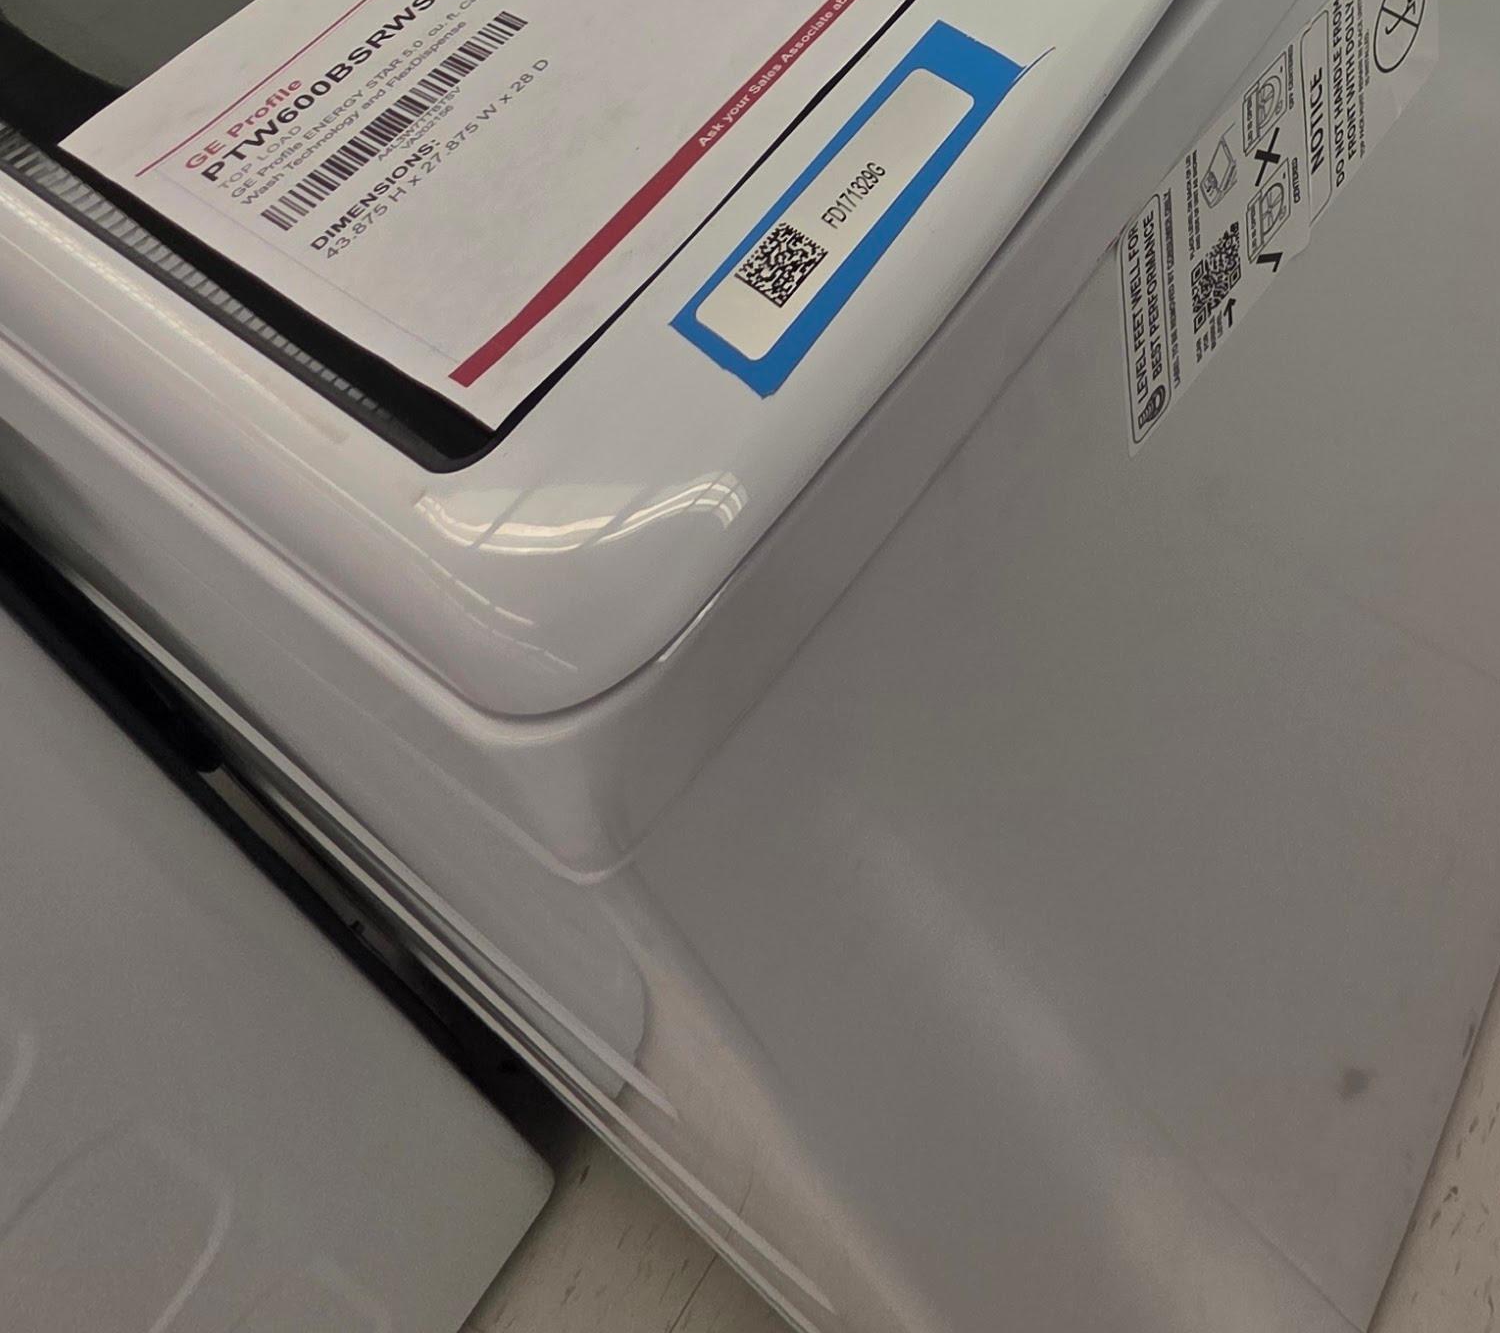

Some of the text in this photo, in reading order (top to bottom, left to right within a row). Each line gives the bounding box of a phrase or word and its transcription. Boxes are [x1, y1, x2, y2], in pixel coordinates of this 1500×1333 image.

[230, 178, 259, 199] GE
[256, 141, 304, 178] Profile
[303, 89, 364, 141] ENERGY
[364, 57, 403, 91] STAR
[402, 39, 424, 59] 5.0
[428, 21, 449, 37] cu.
[698, 121, 725, 148] Ask
[721, 95, 751, 124] your
[749, 63, 782, 96] Sales
[780, 10, 834, 64] Associate
[1332, 47, 1344, 120] HANDLE
[1346, 57, 1356, 107] WITH
[184, 80, 302, 169] GE Profile
[240, 21, 468, 206] Wash Technology and FlexDispense
[1310, 67, 1325, 176] NOTICE
[1334, 119, 1344, 159] NOT
[1347, 105, 1357, 161] FRONT
[217, 124, 303, 190] TOP LOAD
[326, 58, 549, 259] 43.875 H x 27.875 W x 28 D
[1290, 157, 1301, 204] CENTERED
[1335, 160, 1345, 187] DO
[309, 138, 441, 251] DIMENSIONS:
[820, 161, 887, 230] FD171329G
[1143, 210, 1163, 381] BEST PERFORMANCE
[1166, 268, 1175, 284] BY
[1166, 283, 1177, 330] REMOVED
[1127, 220, 1149, 404] LEVEL FEET WELL FOR
[1169, 328, 1178, 342] BE
[1171, 342, 1179, 356] TO
[1171, 354, 1181, 390] LABEL
